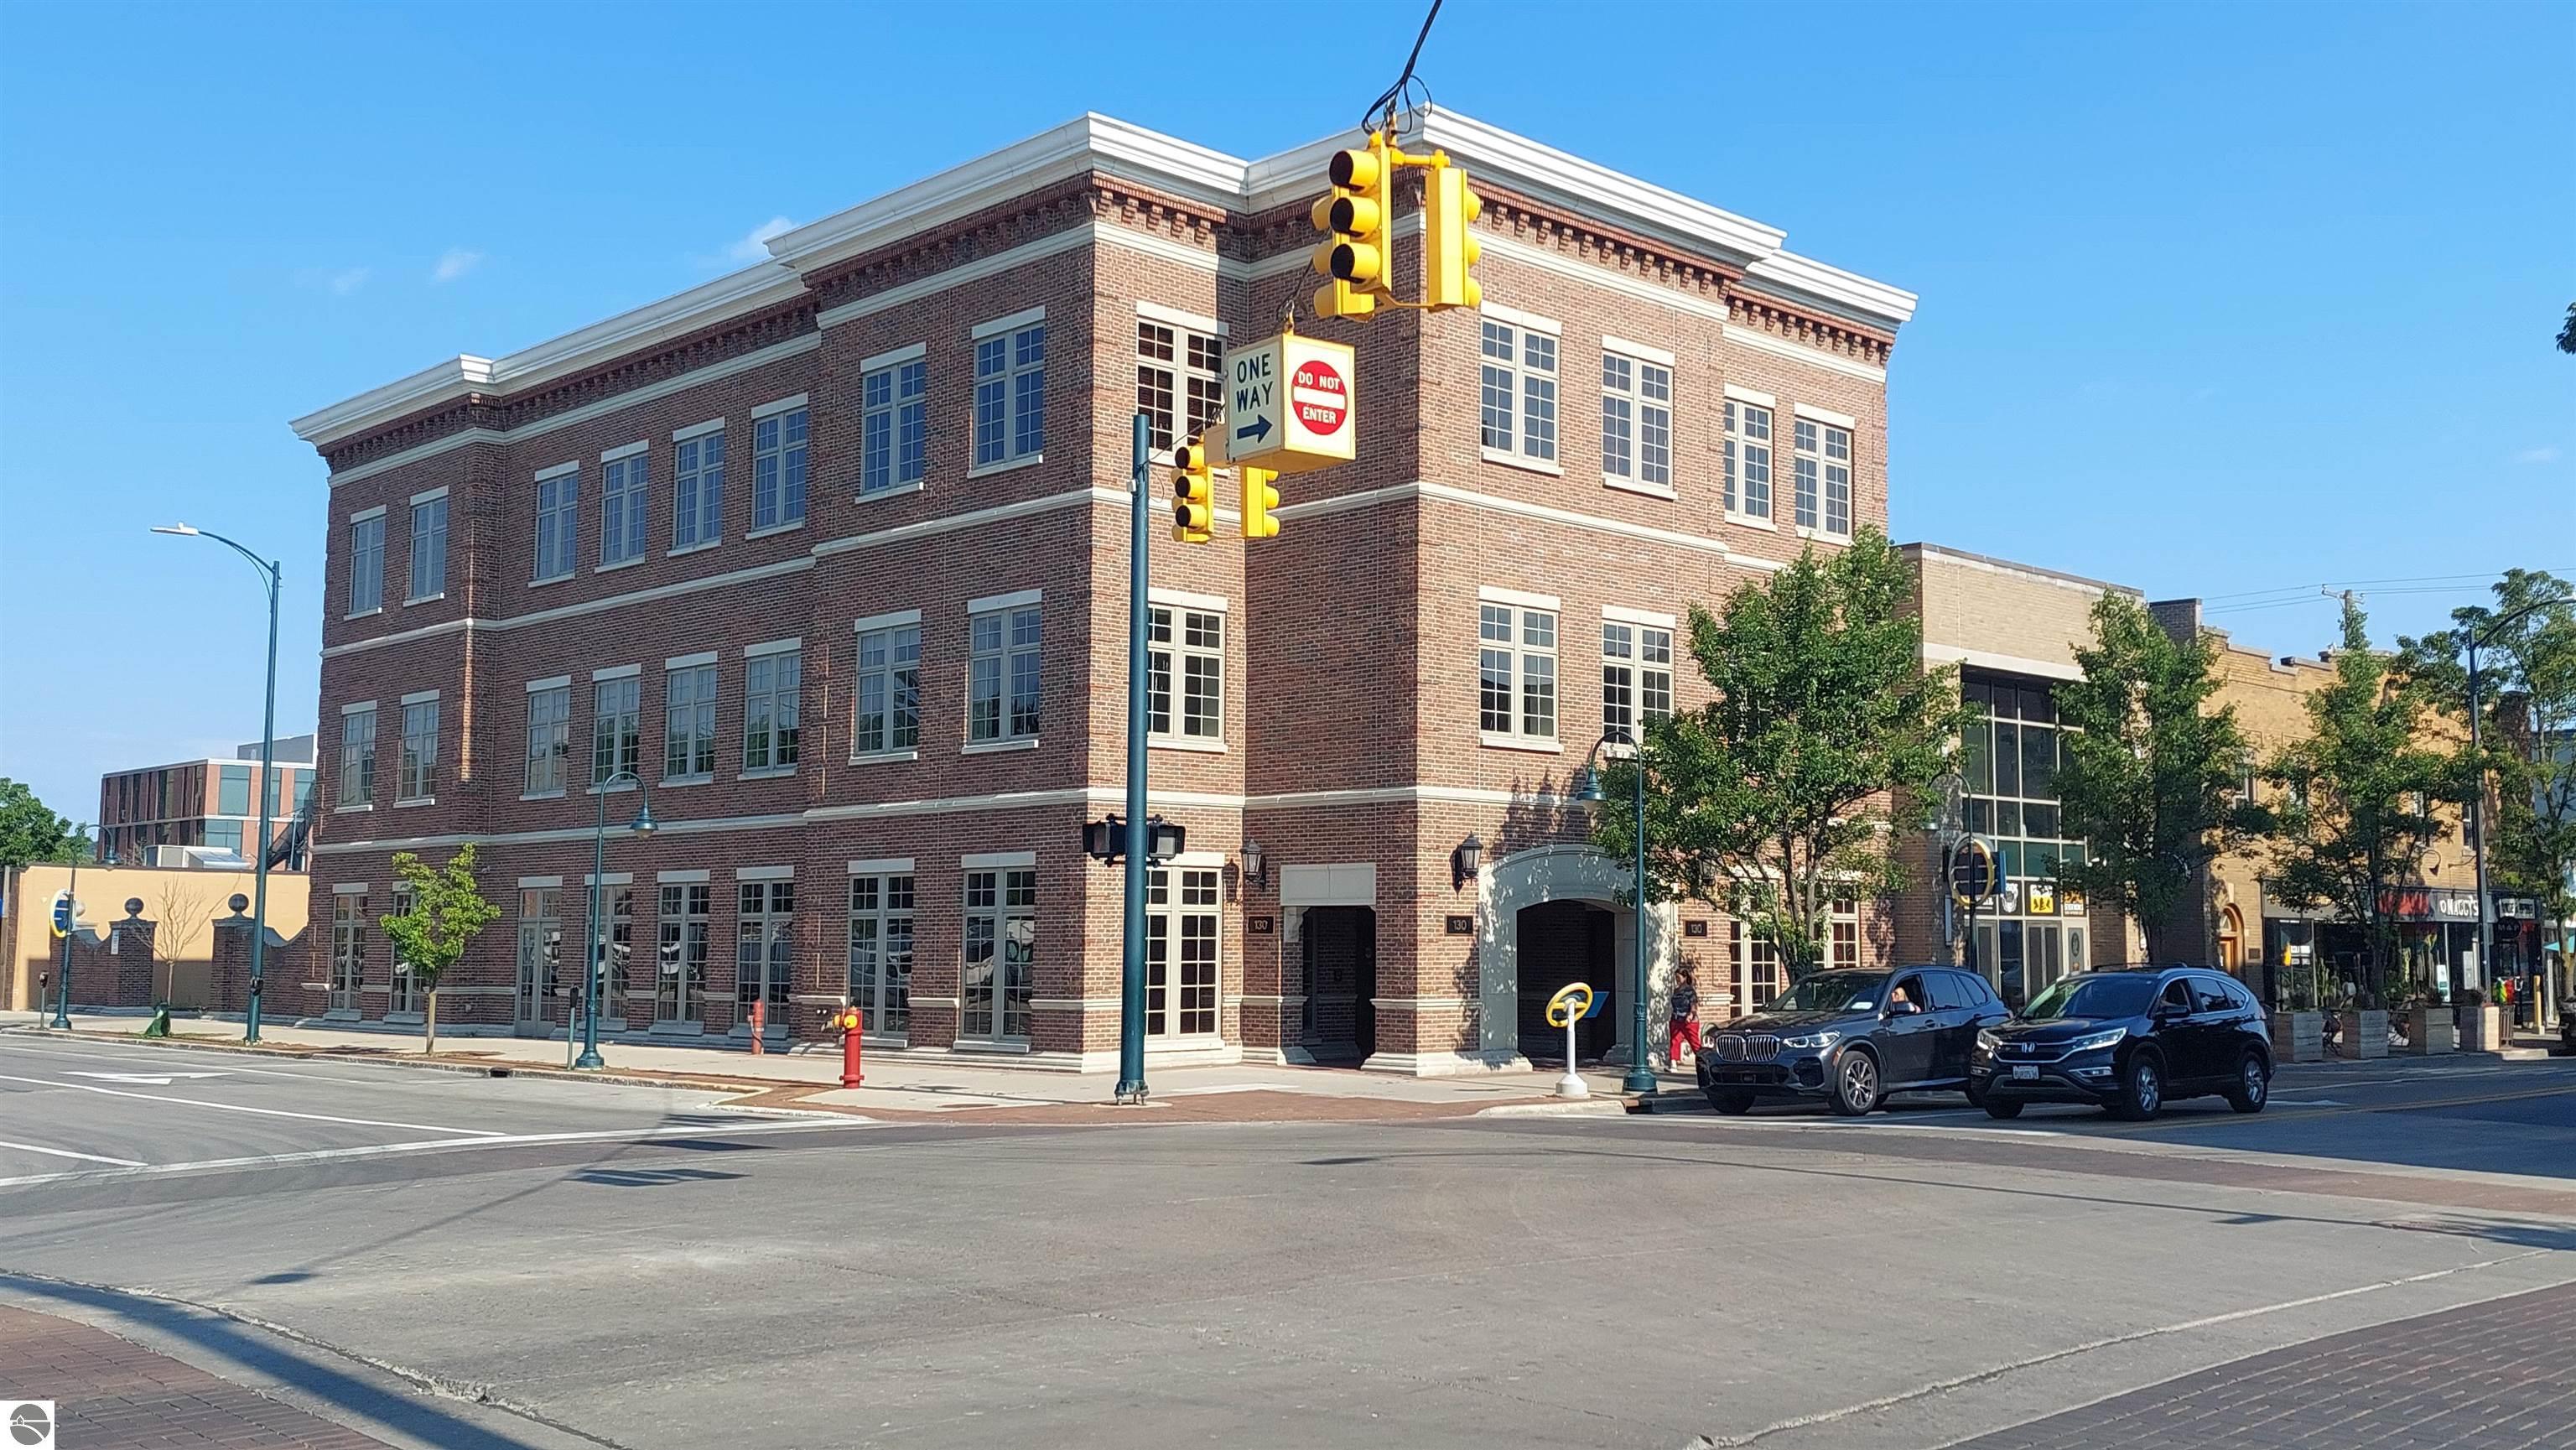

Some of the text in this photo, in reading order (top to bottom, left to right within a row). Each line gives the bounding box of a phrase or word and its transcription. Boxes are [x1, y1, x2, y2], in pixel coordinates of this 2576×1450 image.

[1237, 353, 1271, 384] ONE
[1298, 371, 1341, 391] DO NOT
[1236, 381, 1273, 413] WAY
[1302, 406, 1337, 424] ENTER
[1254, 919, 1268, 930] 130
[1453, 919, 1467, 931] 130
